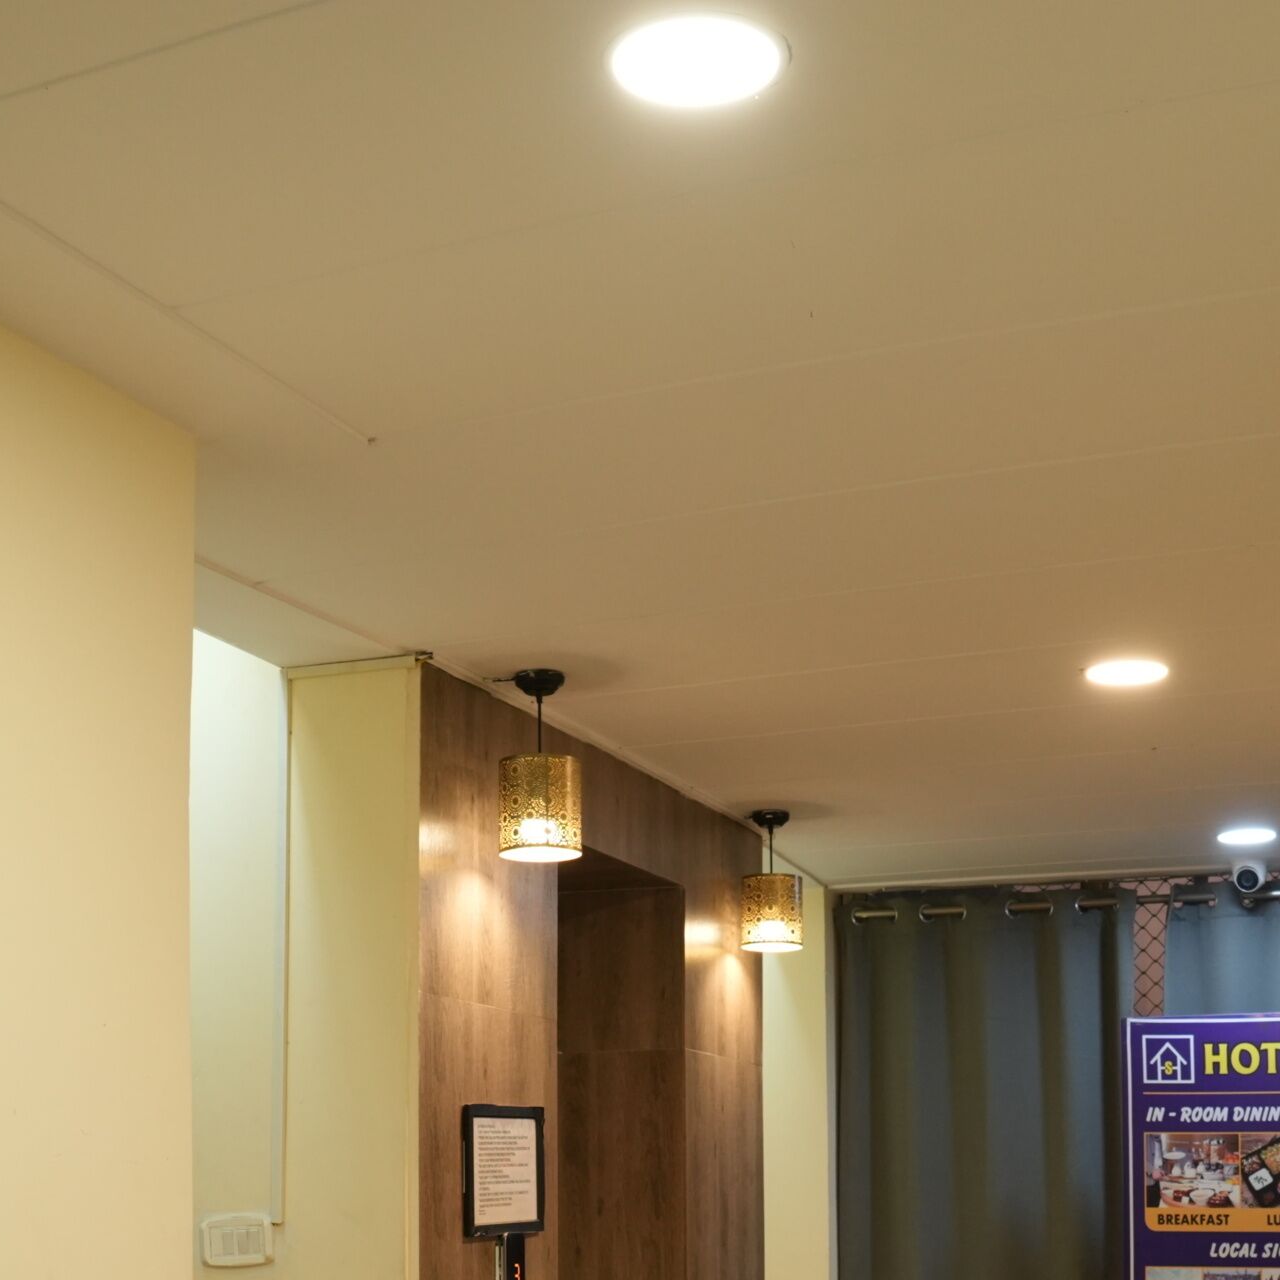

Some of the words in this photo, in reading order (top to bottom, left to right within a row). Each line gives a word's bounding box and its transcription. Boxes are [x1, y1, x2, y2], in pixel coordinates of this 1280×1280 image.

[1146, 1107, 1165, 1122] IN
[1180, 1107, 1229, 1123] ROOM
[1157, 1214, 1230, 1226] BREAKFAST
[1210, 1243, 1258, 1258] LOCAL
